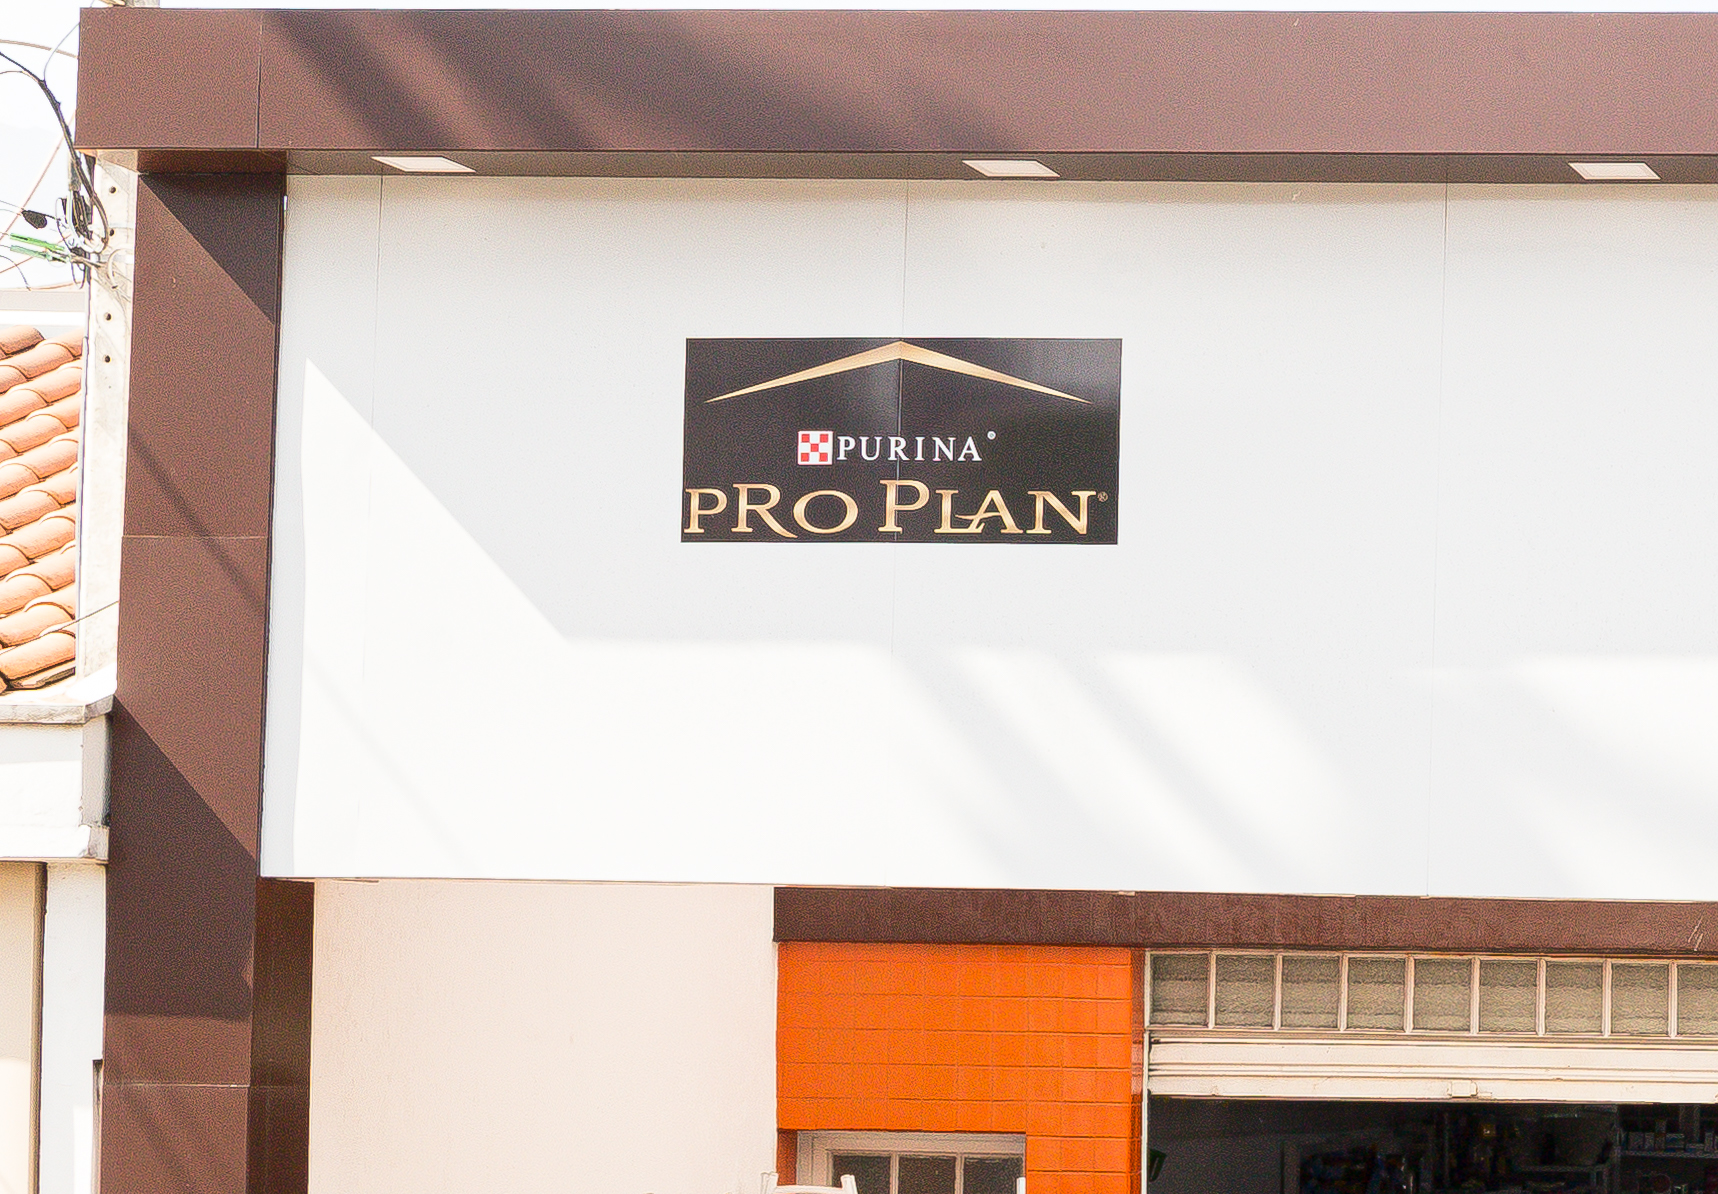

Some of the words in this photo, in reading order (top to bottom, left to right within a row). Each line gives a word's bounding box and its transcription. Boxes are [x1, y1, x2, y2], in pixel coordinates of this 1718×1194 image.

[836, 435, 983, 462] PURINA
[684, 483, 859, 538] PRO
[878, 479, 1097, 535] PLAN
